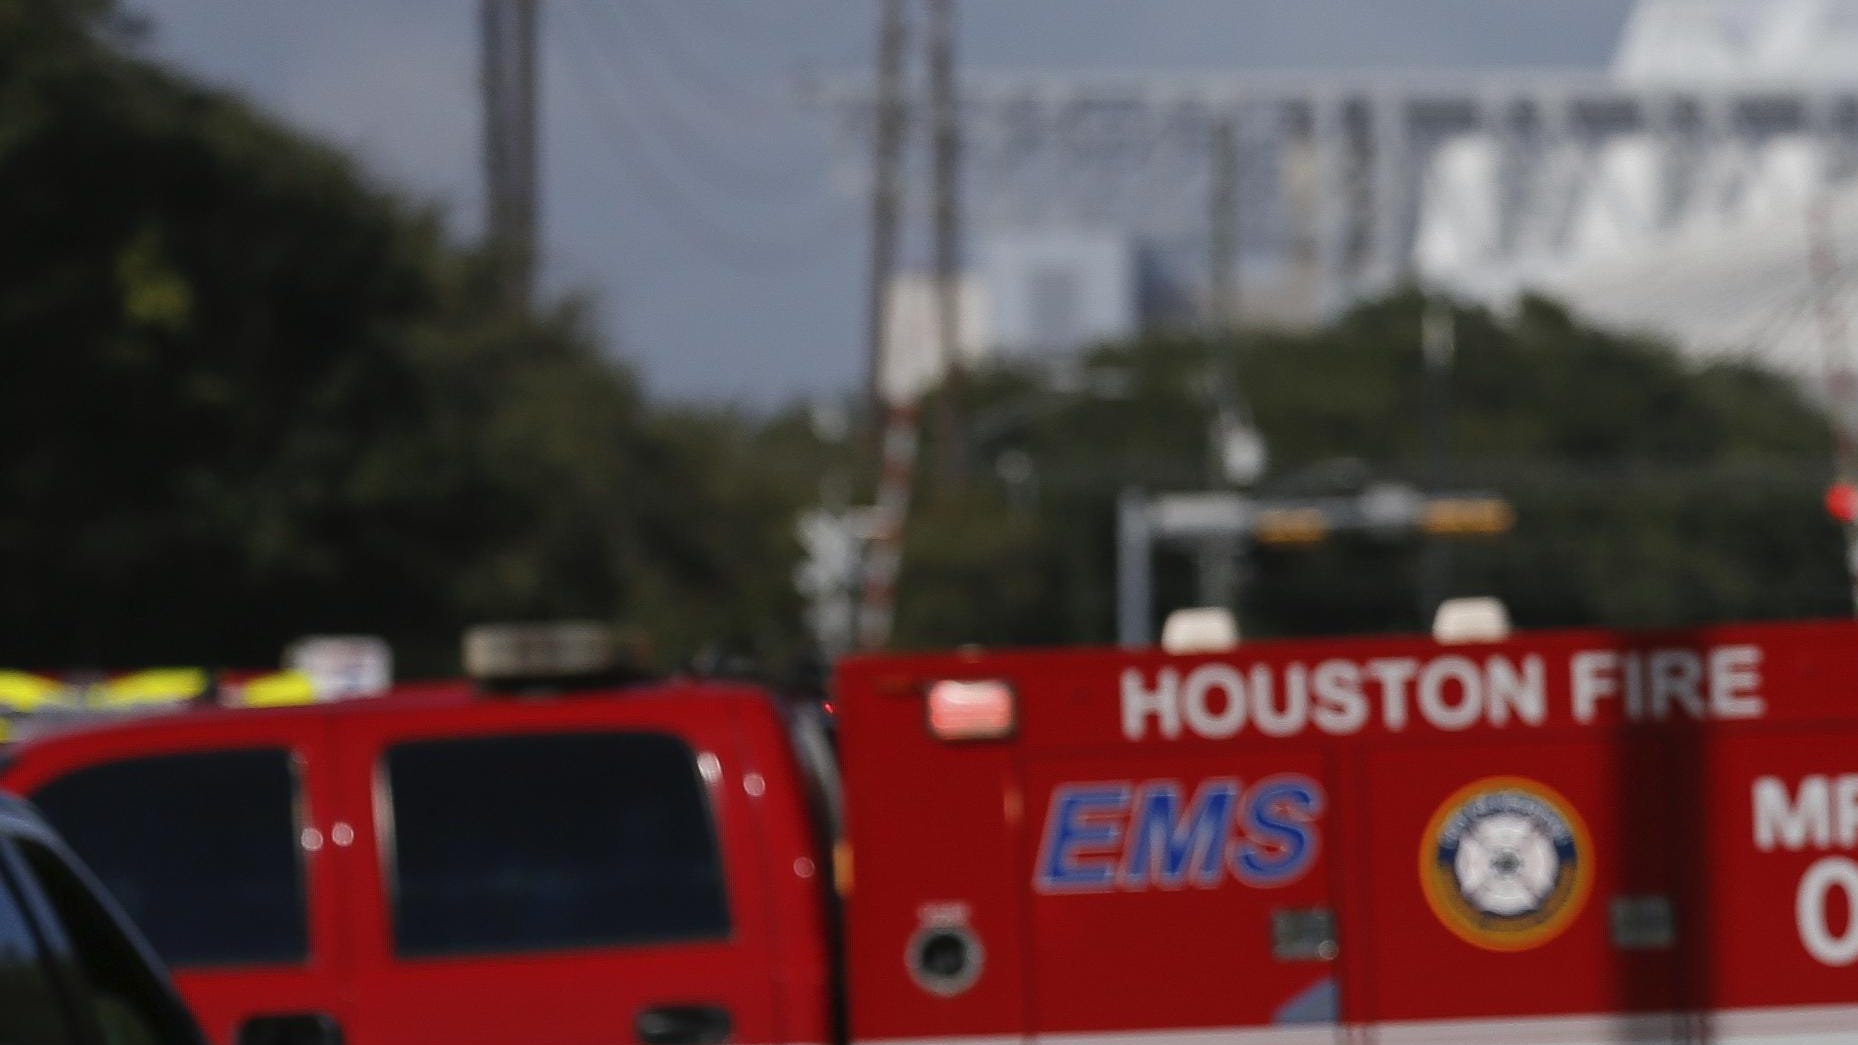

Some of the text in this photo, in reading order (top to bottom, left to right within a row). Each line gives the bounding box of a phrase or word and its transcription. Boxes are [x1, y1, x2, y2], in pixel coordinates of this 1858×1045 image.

[1120, 647, 1767, 738] HOUSTON FIRE
[1034, 774, 1324, 894] EMS
